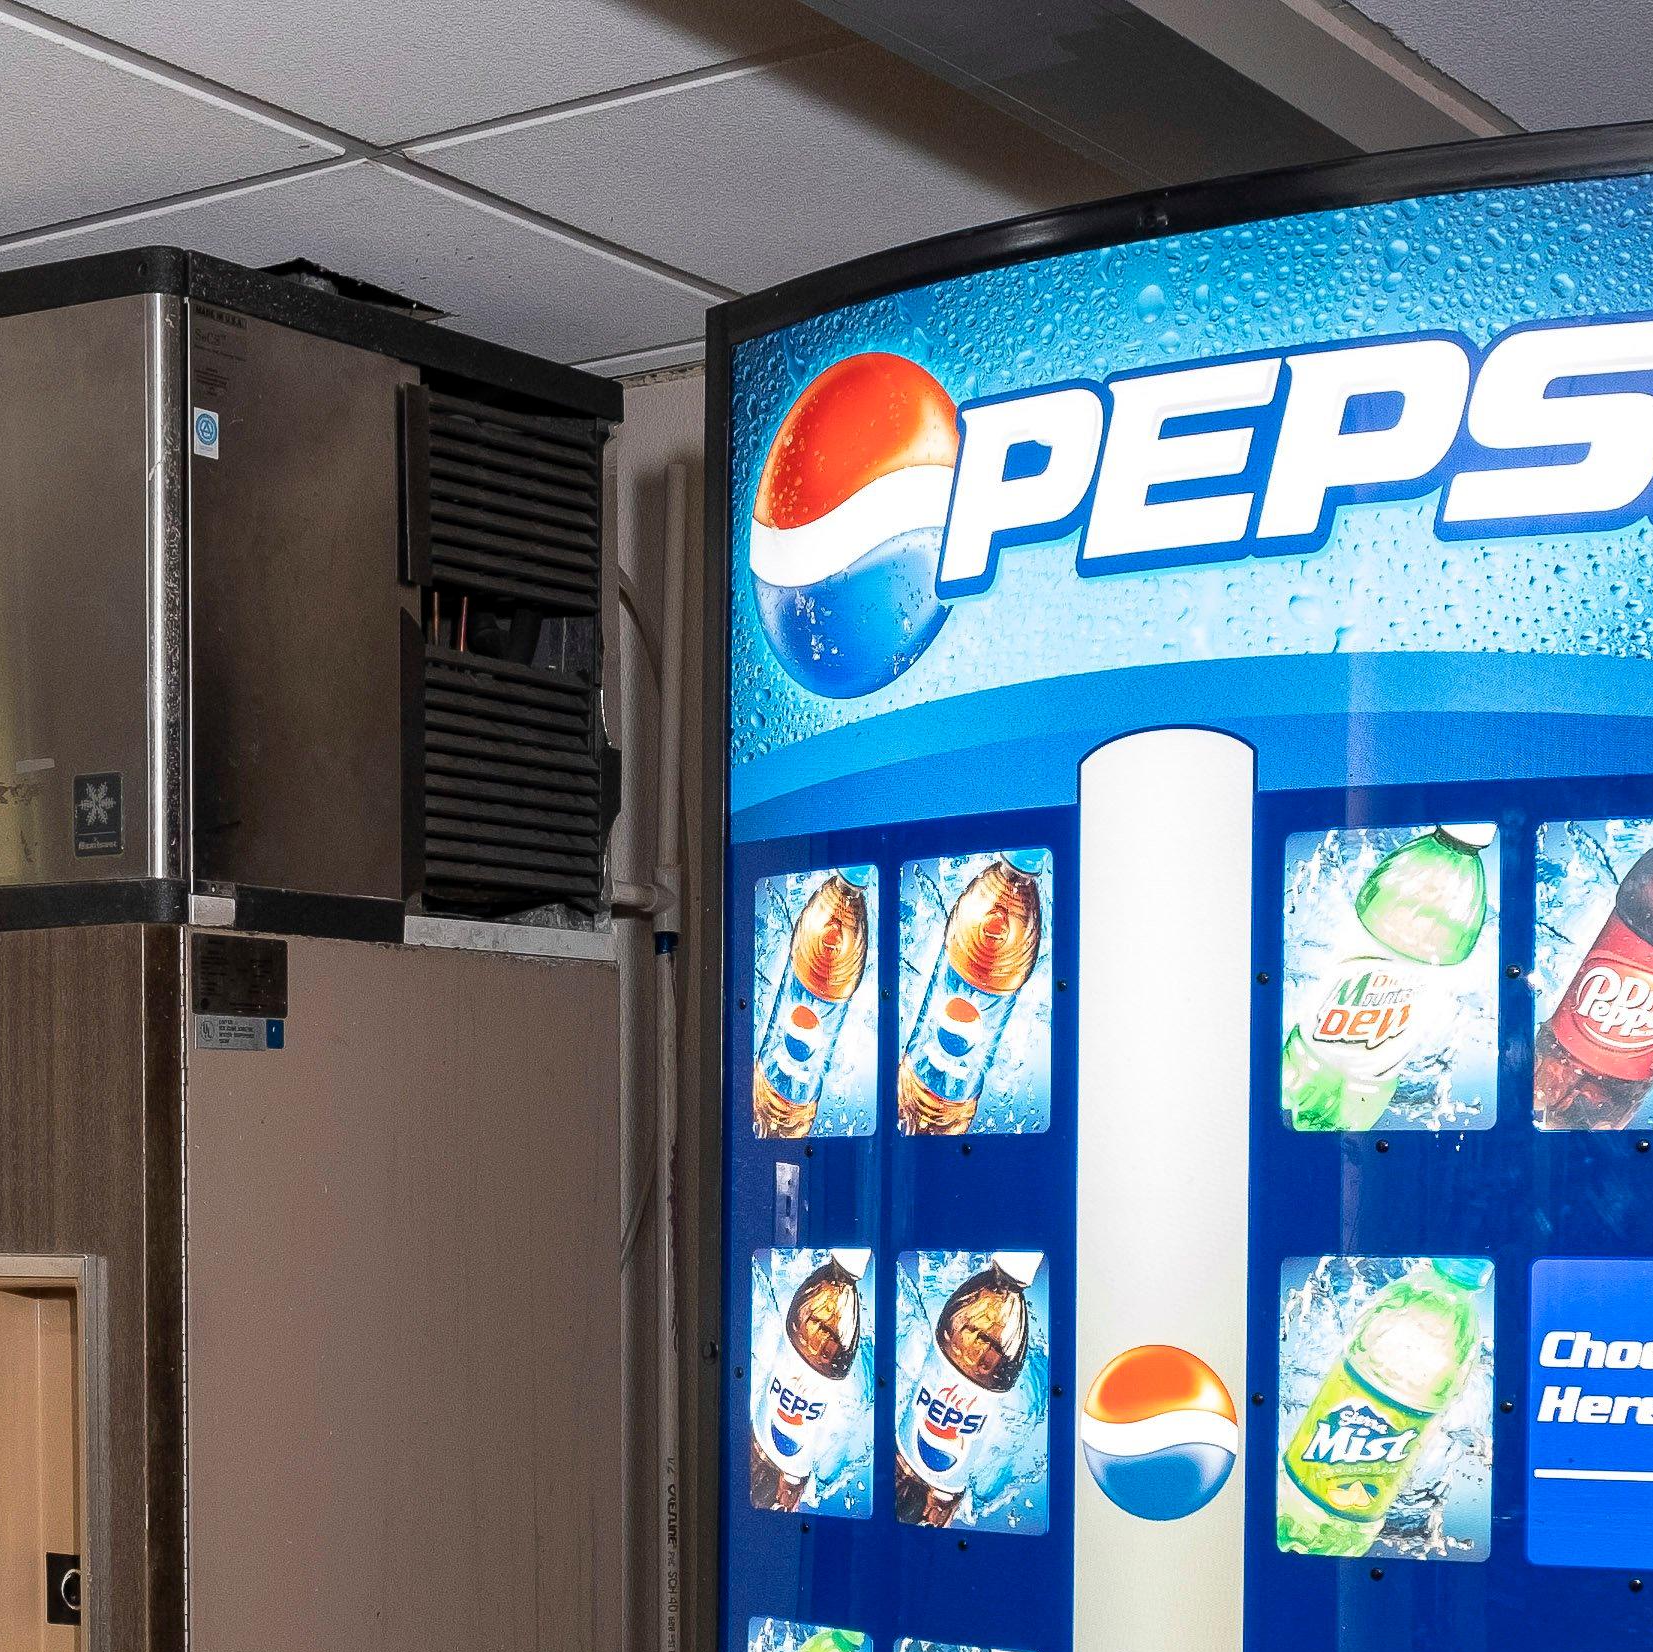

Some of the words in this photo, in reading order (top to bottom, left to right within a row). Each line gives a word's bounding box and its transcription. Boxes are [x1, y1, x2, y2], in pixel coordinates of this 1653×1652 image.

[769, 1376, 828, 1421] PEPSI
[916, 1386, 988, 1434] PEPSI
[1301, 1419, 1419, 1464] Mist
